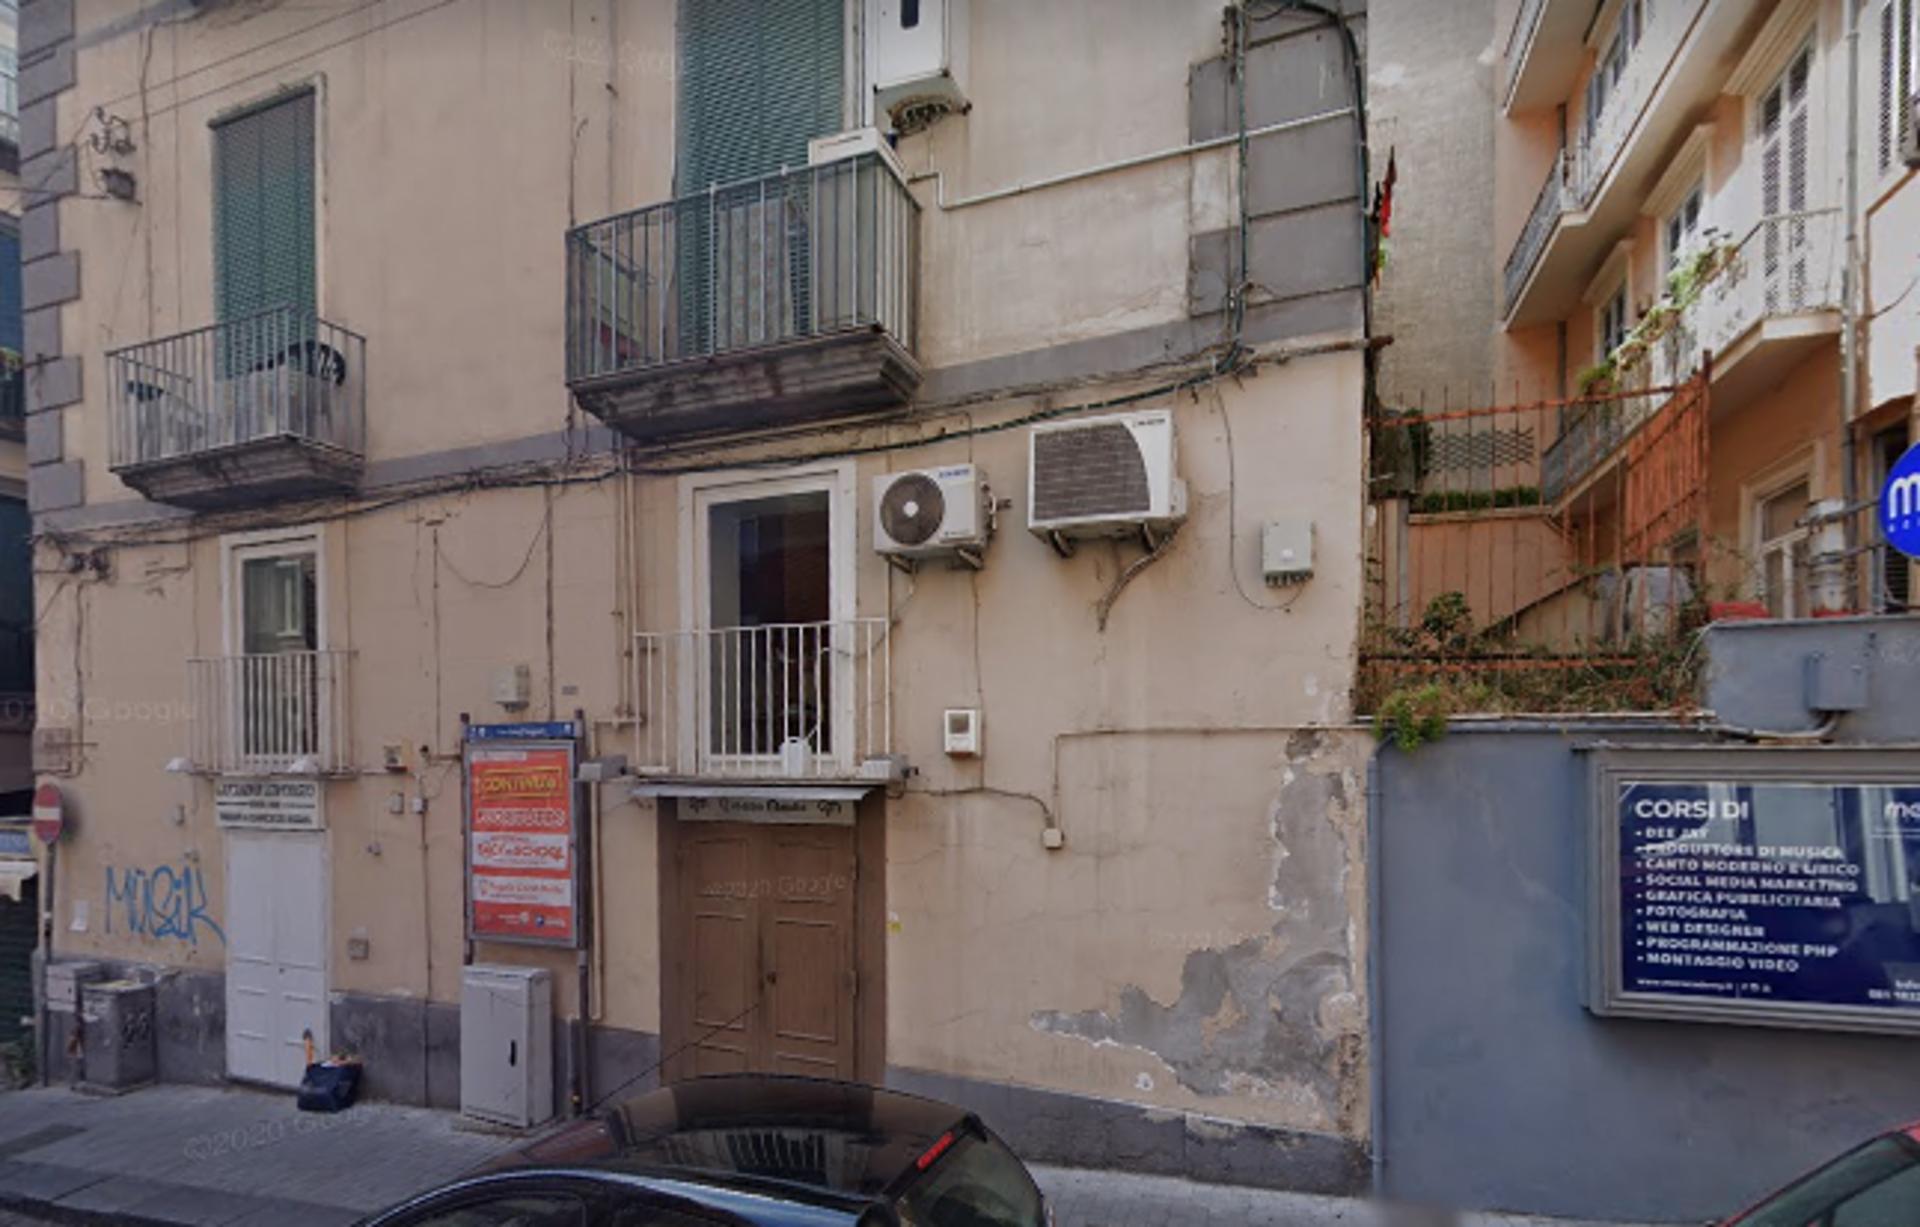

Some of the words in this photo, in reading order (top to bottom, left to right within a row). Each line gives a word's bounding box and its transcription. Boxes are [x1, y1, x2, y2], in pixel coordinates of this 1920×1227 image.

[1635, 799, 1716, 819] CORSI
[1722, 801, 1749, 820] DI
[1645, 827, 1675, 838] DEE
[1758, 846, 1776, 857] DI
[1779, 846, 1845, 860] MUSICA
[1645, 858, 1699, 871] CANTO
[1702, 860, 1785, 873] MODERNO
[1788, 863, 1799, 874] E
[1803, 863, 1860, 876] LIRICO
[1645, 873, 1701, 886] SOCIAL
[1705, 875, 1757, 889] MEDIA
[1759, 877, 1858, 892] MARKETING
[1645, 890, 1713, 904] GRAFICA
[1716, 892, 1841, 907] PUBBLICITARIA
[1645, 905, 1748, 920] FOTOGRAFIA
[1645, 921, 1680, 933] WEB
[1683, 923, 1765, 937] DESIGNER
[1645, 936, 1799, 955] PROGRAMMAZIONE
[1803, 944, 1839, 957] PHP
[1645, 953, 1745, 969] MONTAGGIO
[1747, 958, 1800, 972] VIDEO
